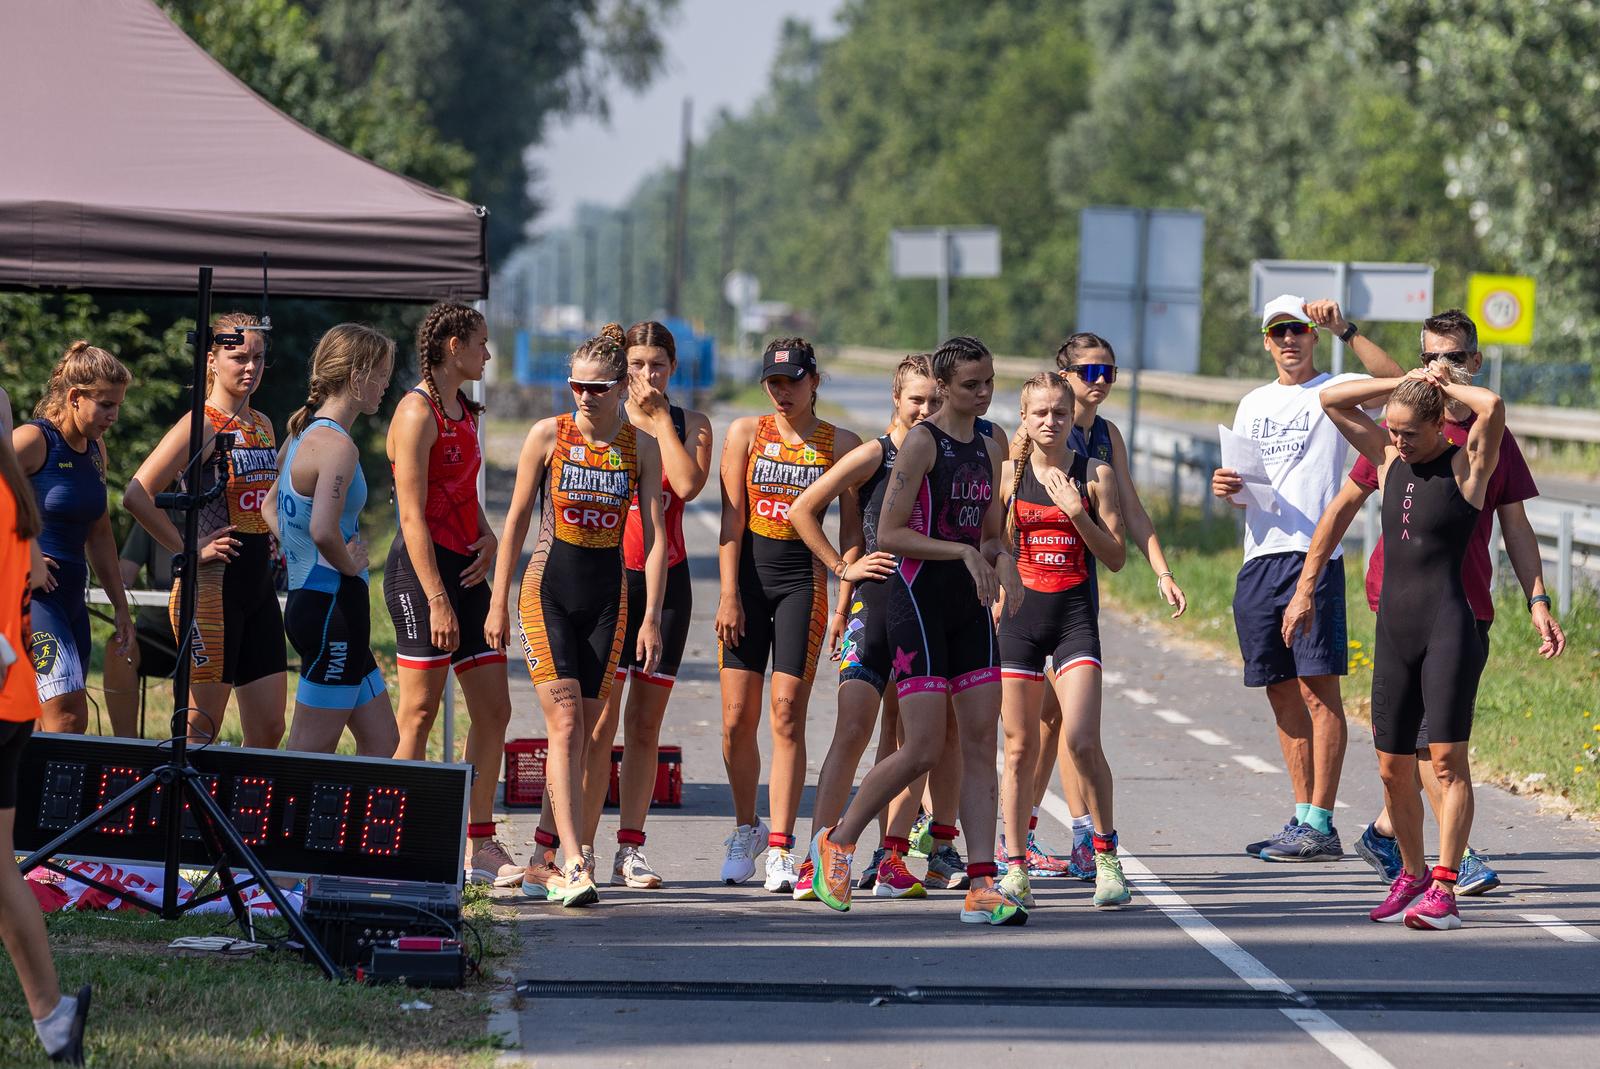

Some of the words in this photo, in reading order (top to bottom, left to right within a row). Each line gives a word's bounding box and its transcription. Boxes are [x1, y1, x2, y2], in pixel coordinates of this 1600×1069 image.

[560, 462, 629, 498] TRIATHLON
[239, 489, 269, 510] CR
[568, 492, 594, 502] CLUB
[595, 495, 623, 506] PULA
[760, 485, 784, 494] CLUB
[785, 488, 801, 497] PU
[563, 507, 619, 529] CRO
[756, 499, 790, 520] CR
[958, 506, 980, 526] CRO
[1027, 536, 1076, 545] FAUSTINI
[1034, 552, 1066, 566] CRO
[324, 641, 348, 681] RIVAL
